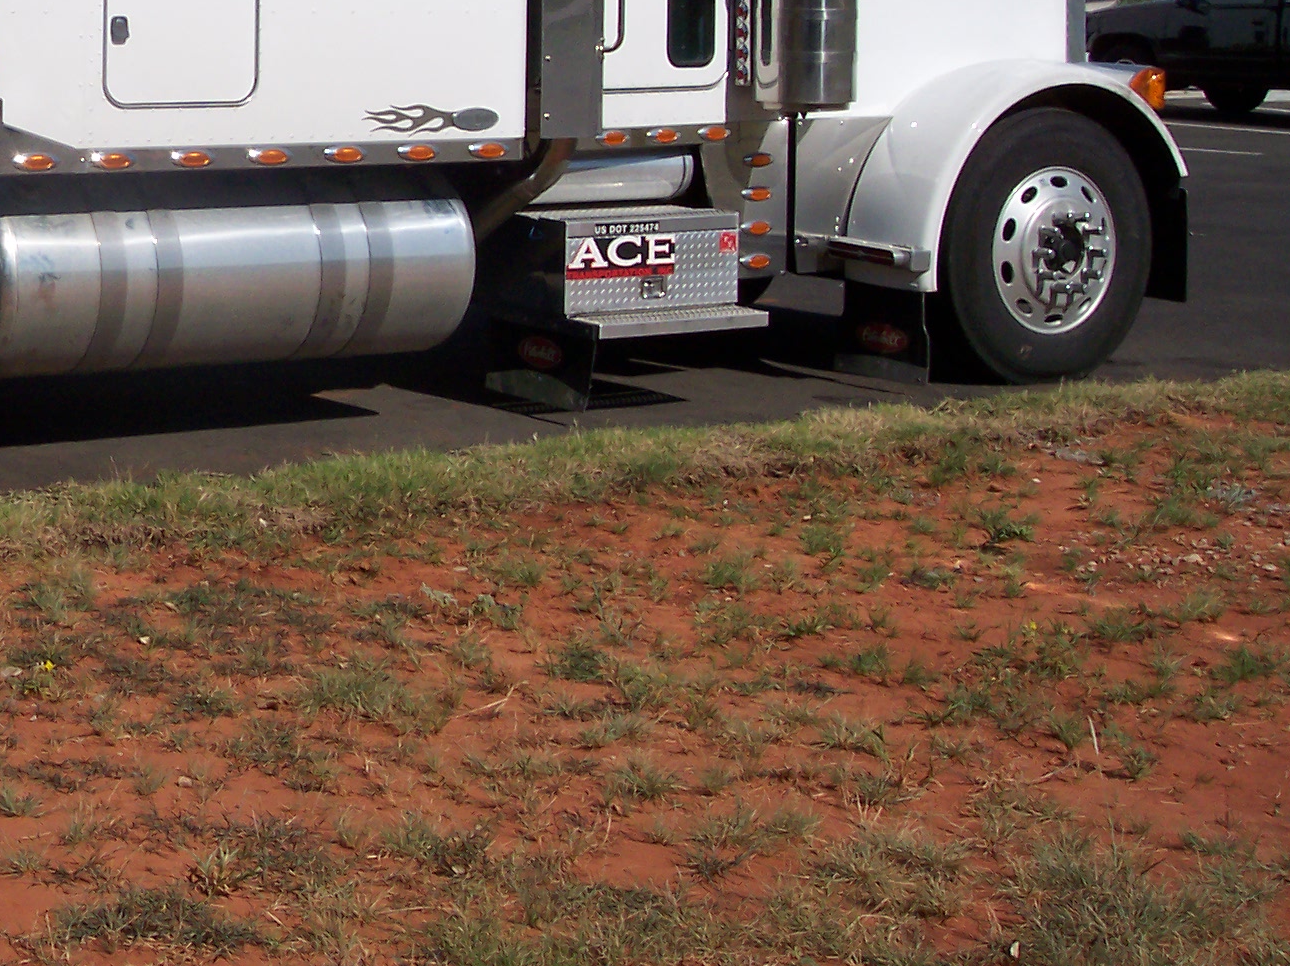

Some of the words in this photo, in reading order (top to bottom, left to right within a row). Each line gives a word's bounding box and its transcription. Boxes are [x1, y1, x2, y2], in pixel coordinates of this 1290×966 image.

[594, 225, 607, 235] US
[609, 224, 628, 235] DOT
[567, 235, 676, 269] ACE
